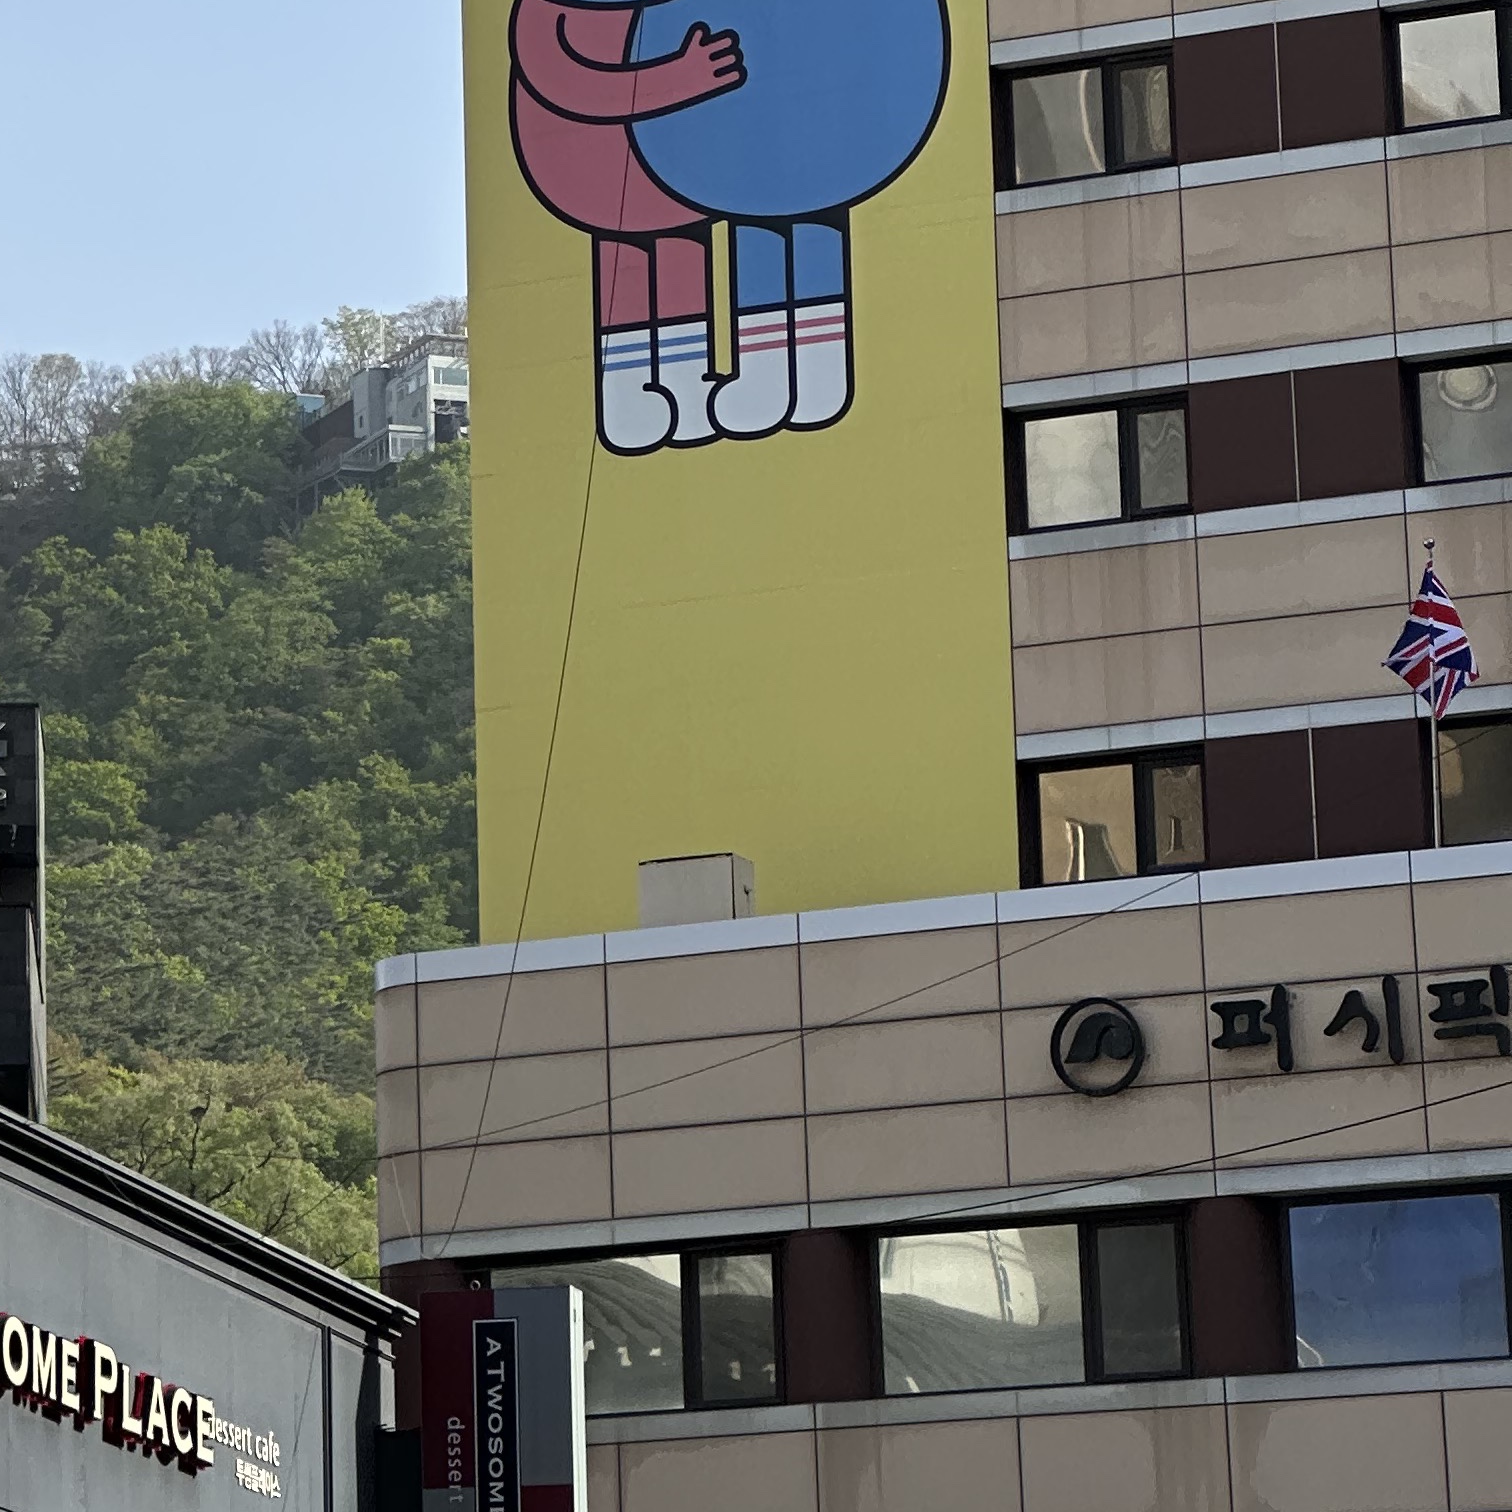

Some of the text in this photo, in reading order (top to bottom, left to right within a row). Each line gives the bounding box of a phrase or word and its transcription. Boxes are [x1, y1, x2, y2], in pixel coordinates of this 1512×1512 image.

[486, 1336, 503, 1357] A
[93, 1339, 216, 1466] PLACE
[255, 1430, 281, 1467] cafe
[446, 1416, 466, 1503] dessert
